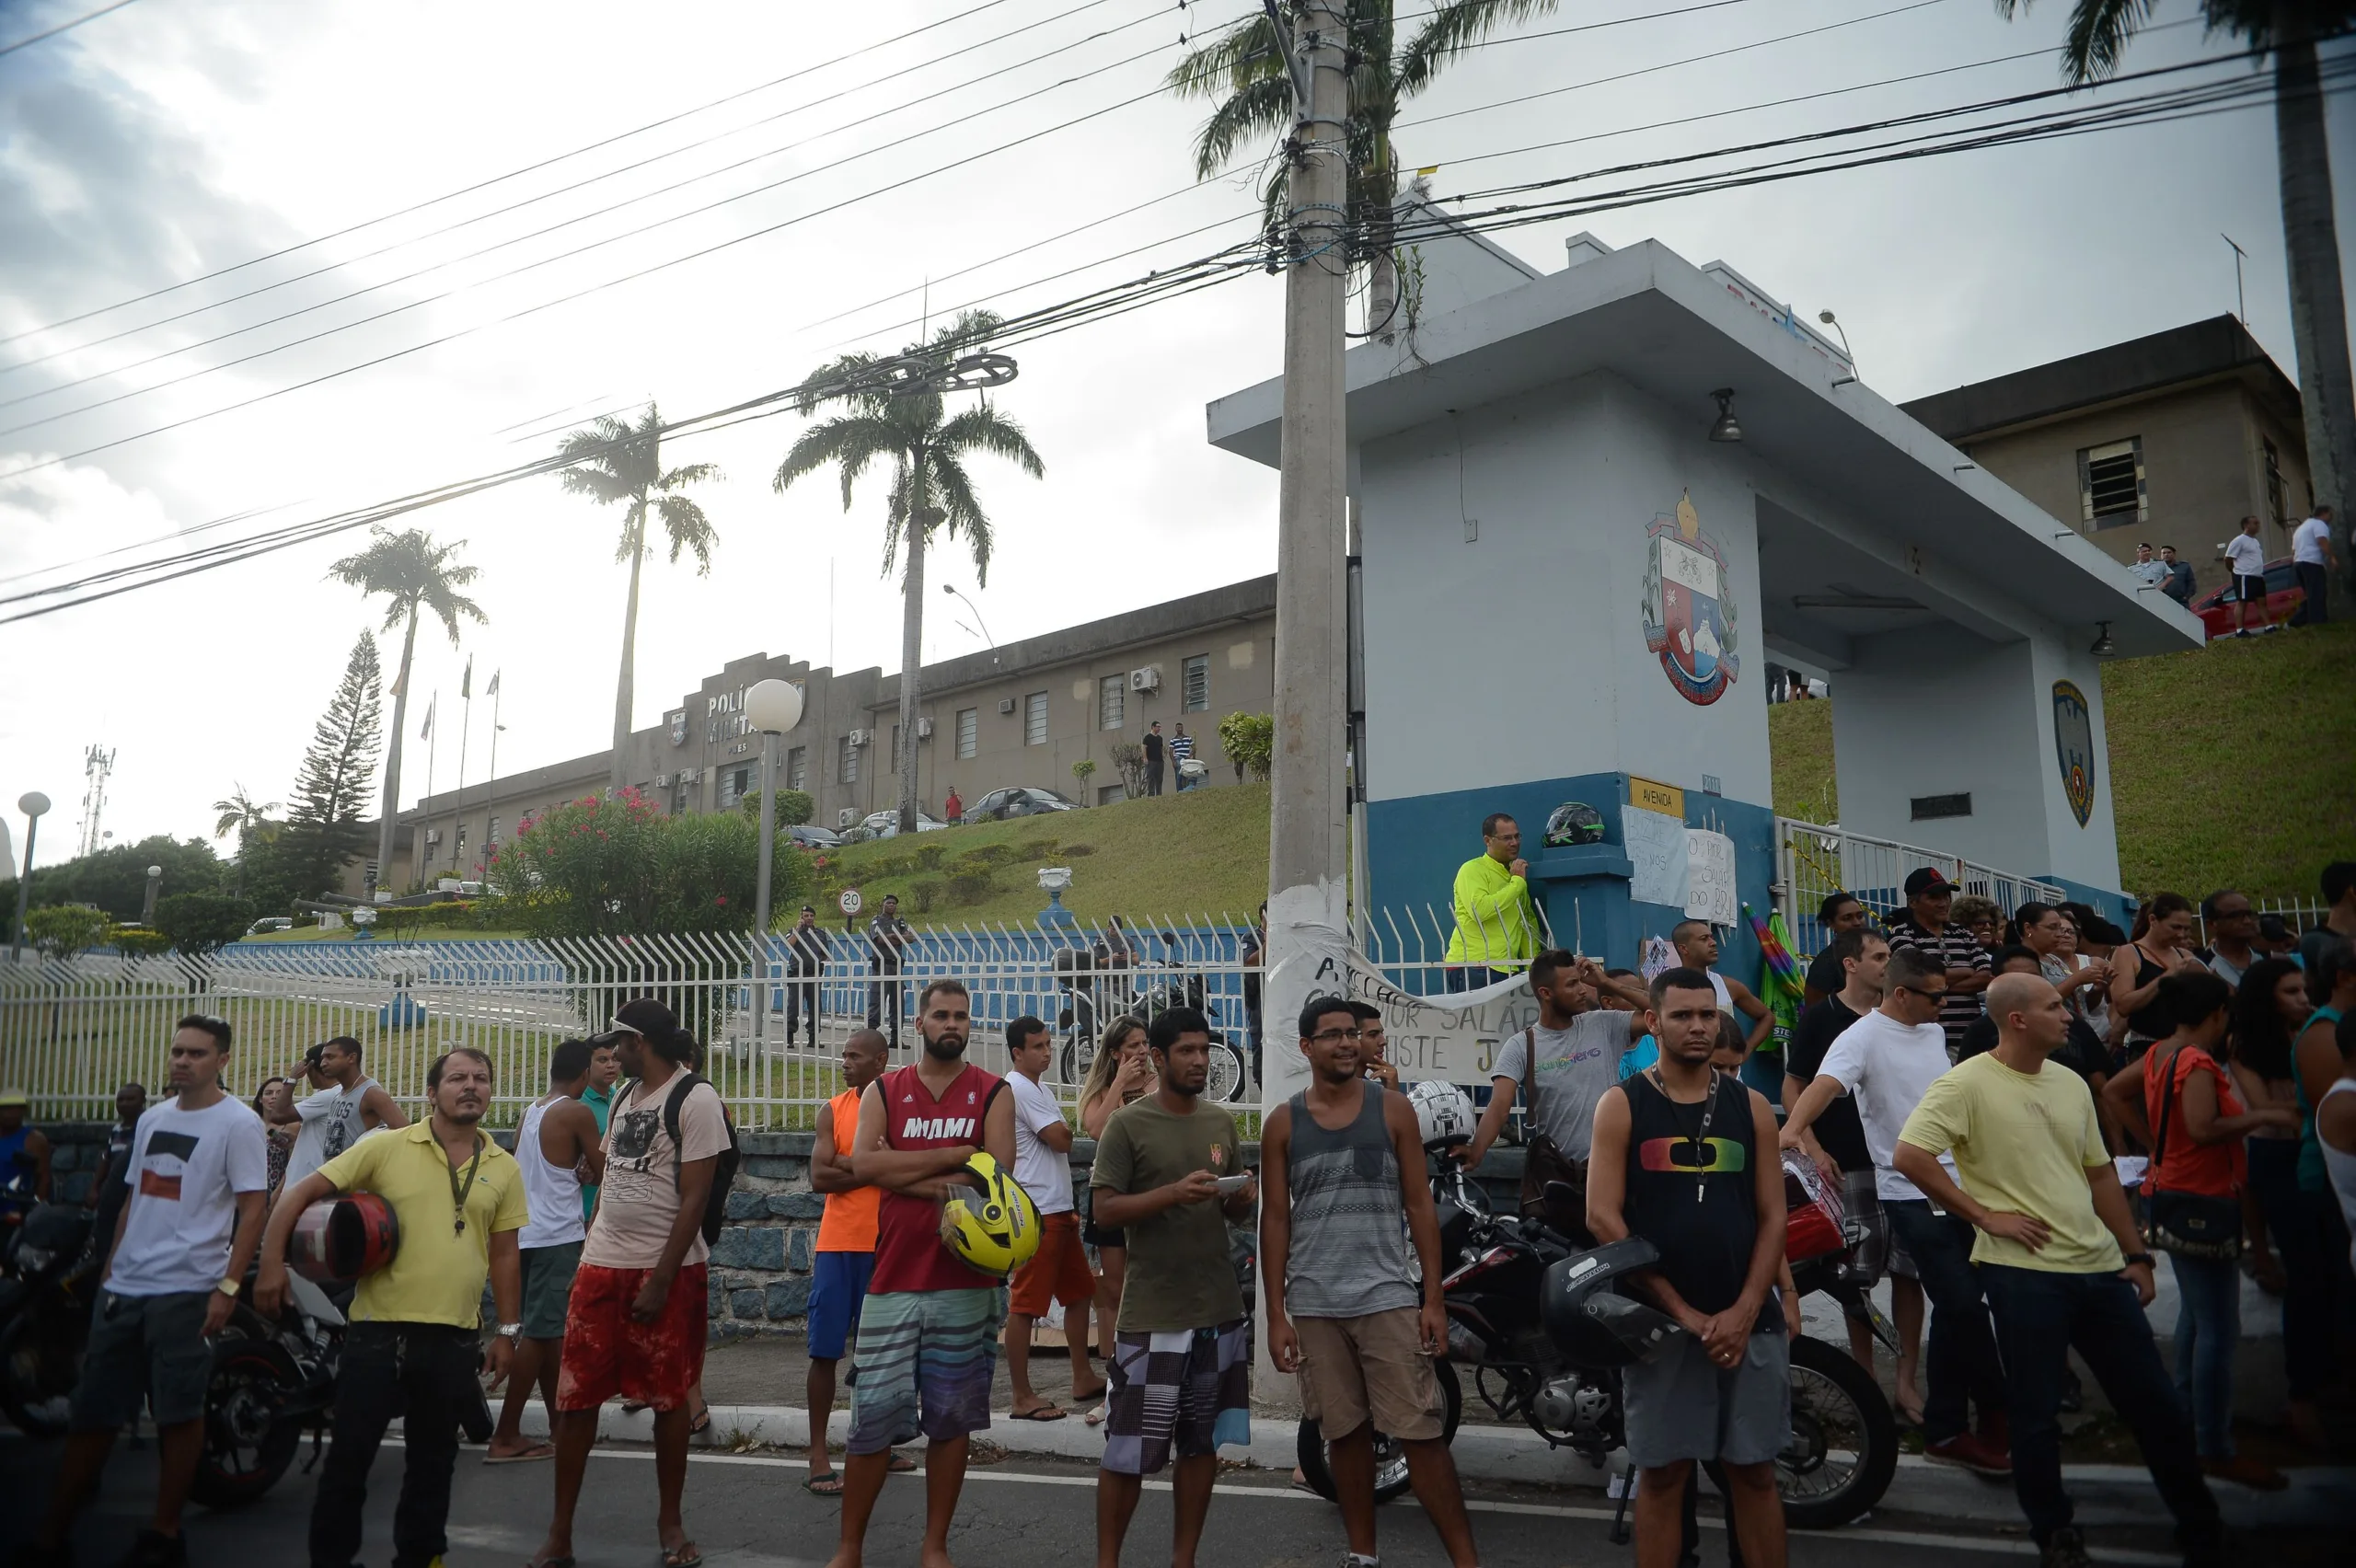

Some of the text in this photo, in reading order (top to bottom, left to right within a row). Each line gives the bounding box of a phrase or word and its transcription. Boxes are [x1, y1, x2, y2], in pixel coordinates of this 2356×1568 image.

[1643, 790, 1672, 808] AVENIDA
[1689, 838, 1724, 860] O PIOR
[1649, 854, 1667, 871] NOS
[843, 894, 859, 905] 20
[1691, 891, 1707, 906] DO
[903, 1117, 976, 1140] MIAMI
